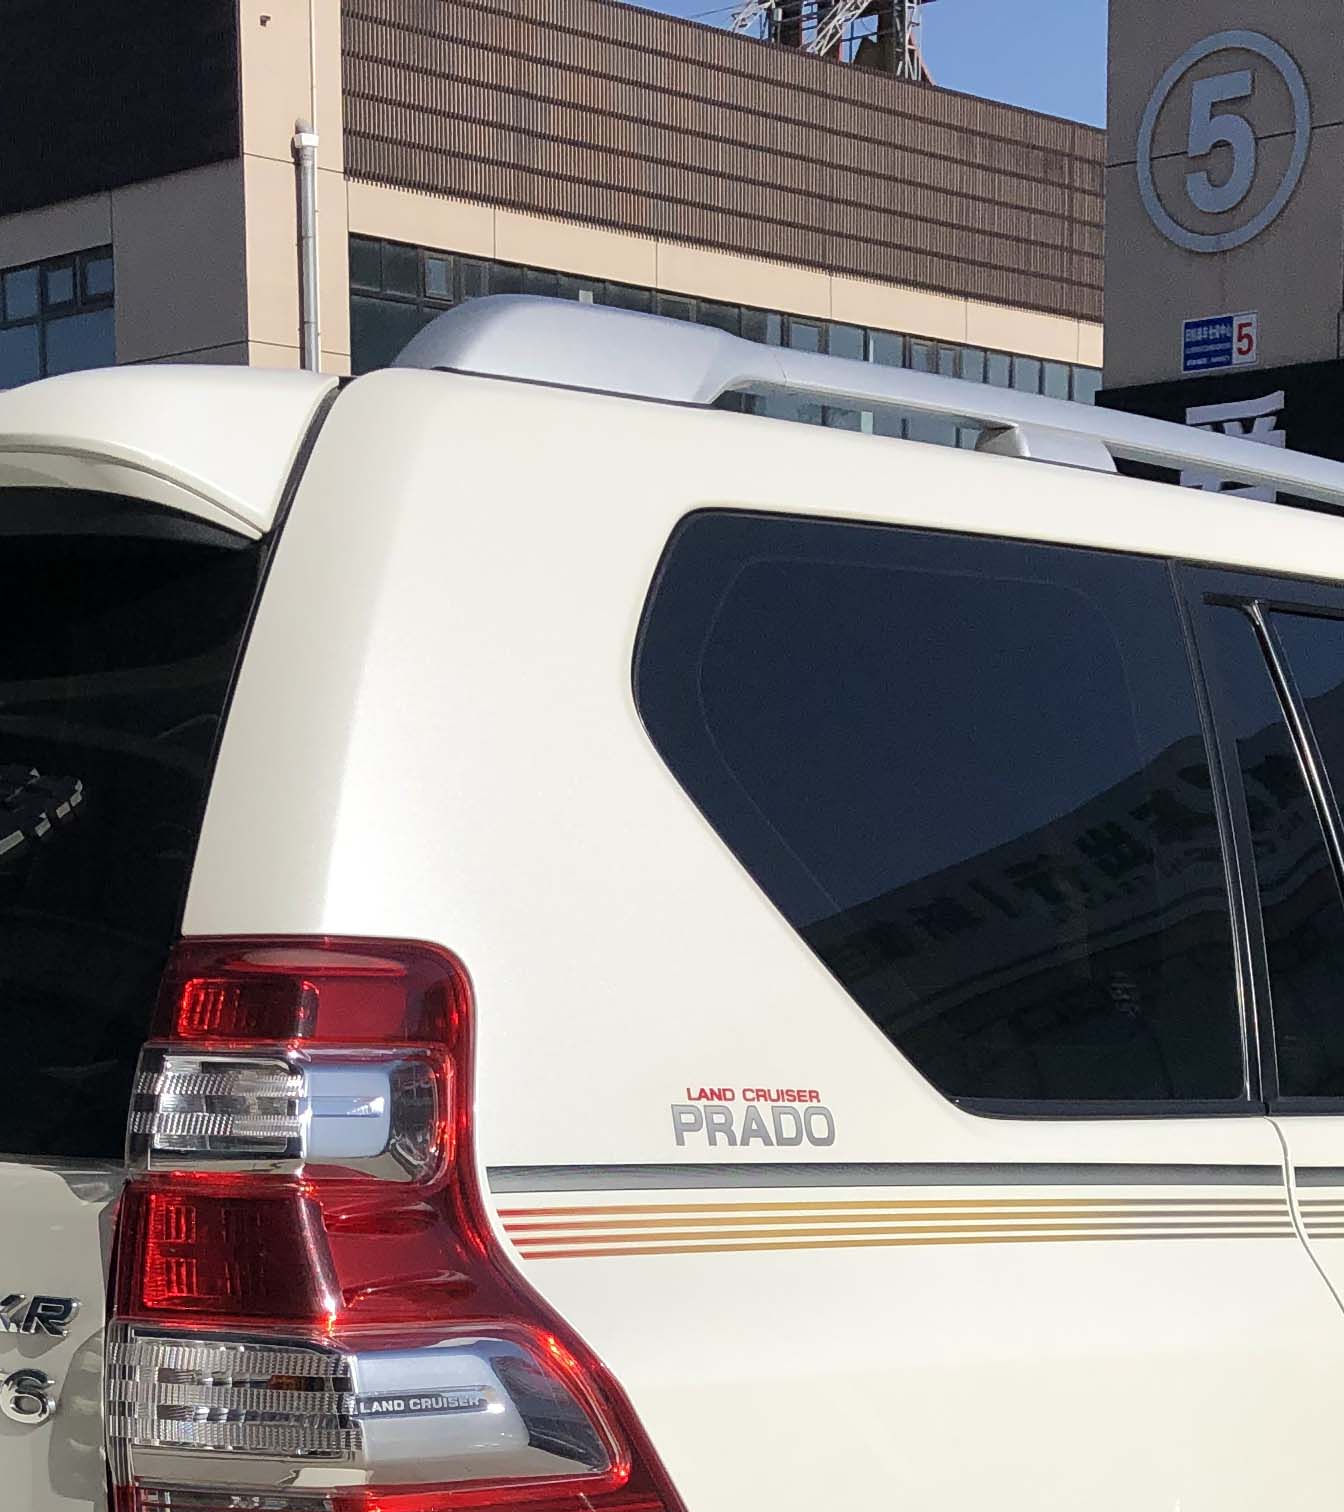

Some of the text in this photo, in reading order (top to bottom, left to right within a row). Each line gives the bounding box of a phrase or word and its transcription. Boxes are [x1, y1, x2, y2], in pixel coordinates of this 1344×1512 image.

[1186, 70, 1255, 214] 5
[1237, 321, 1254, 356] 5
[686, 1087, 821, 1104] LAND CRUISER
[670, 1103, 836, 1147] PRADO
[359, 1394, 481, 1414] LAND CRUISER
